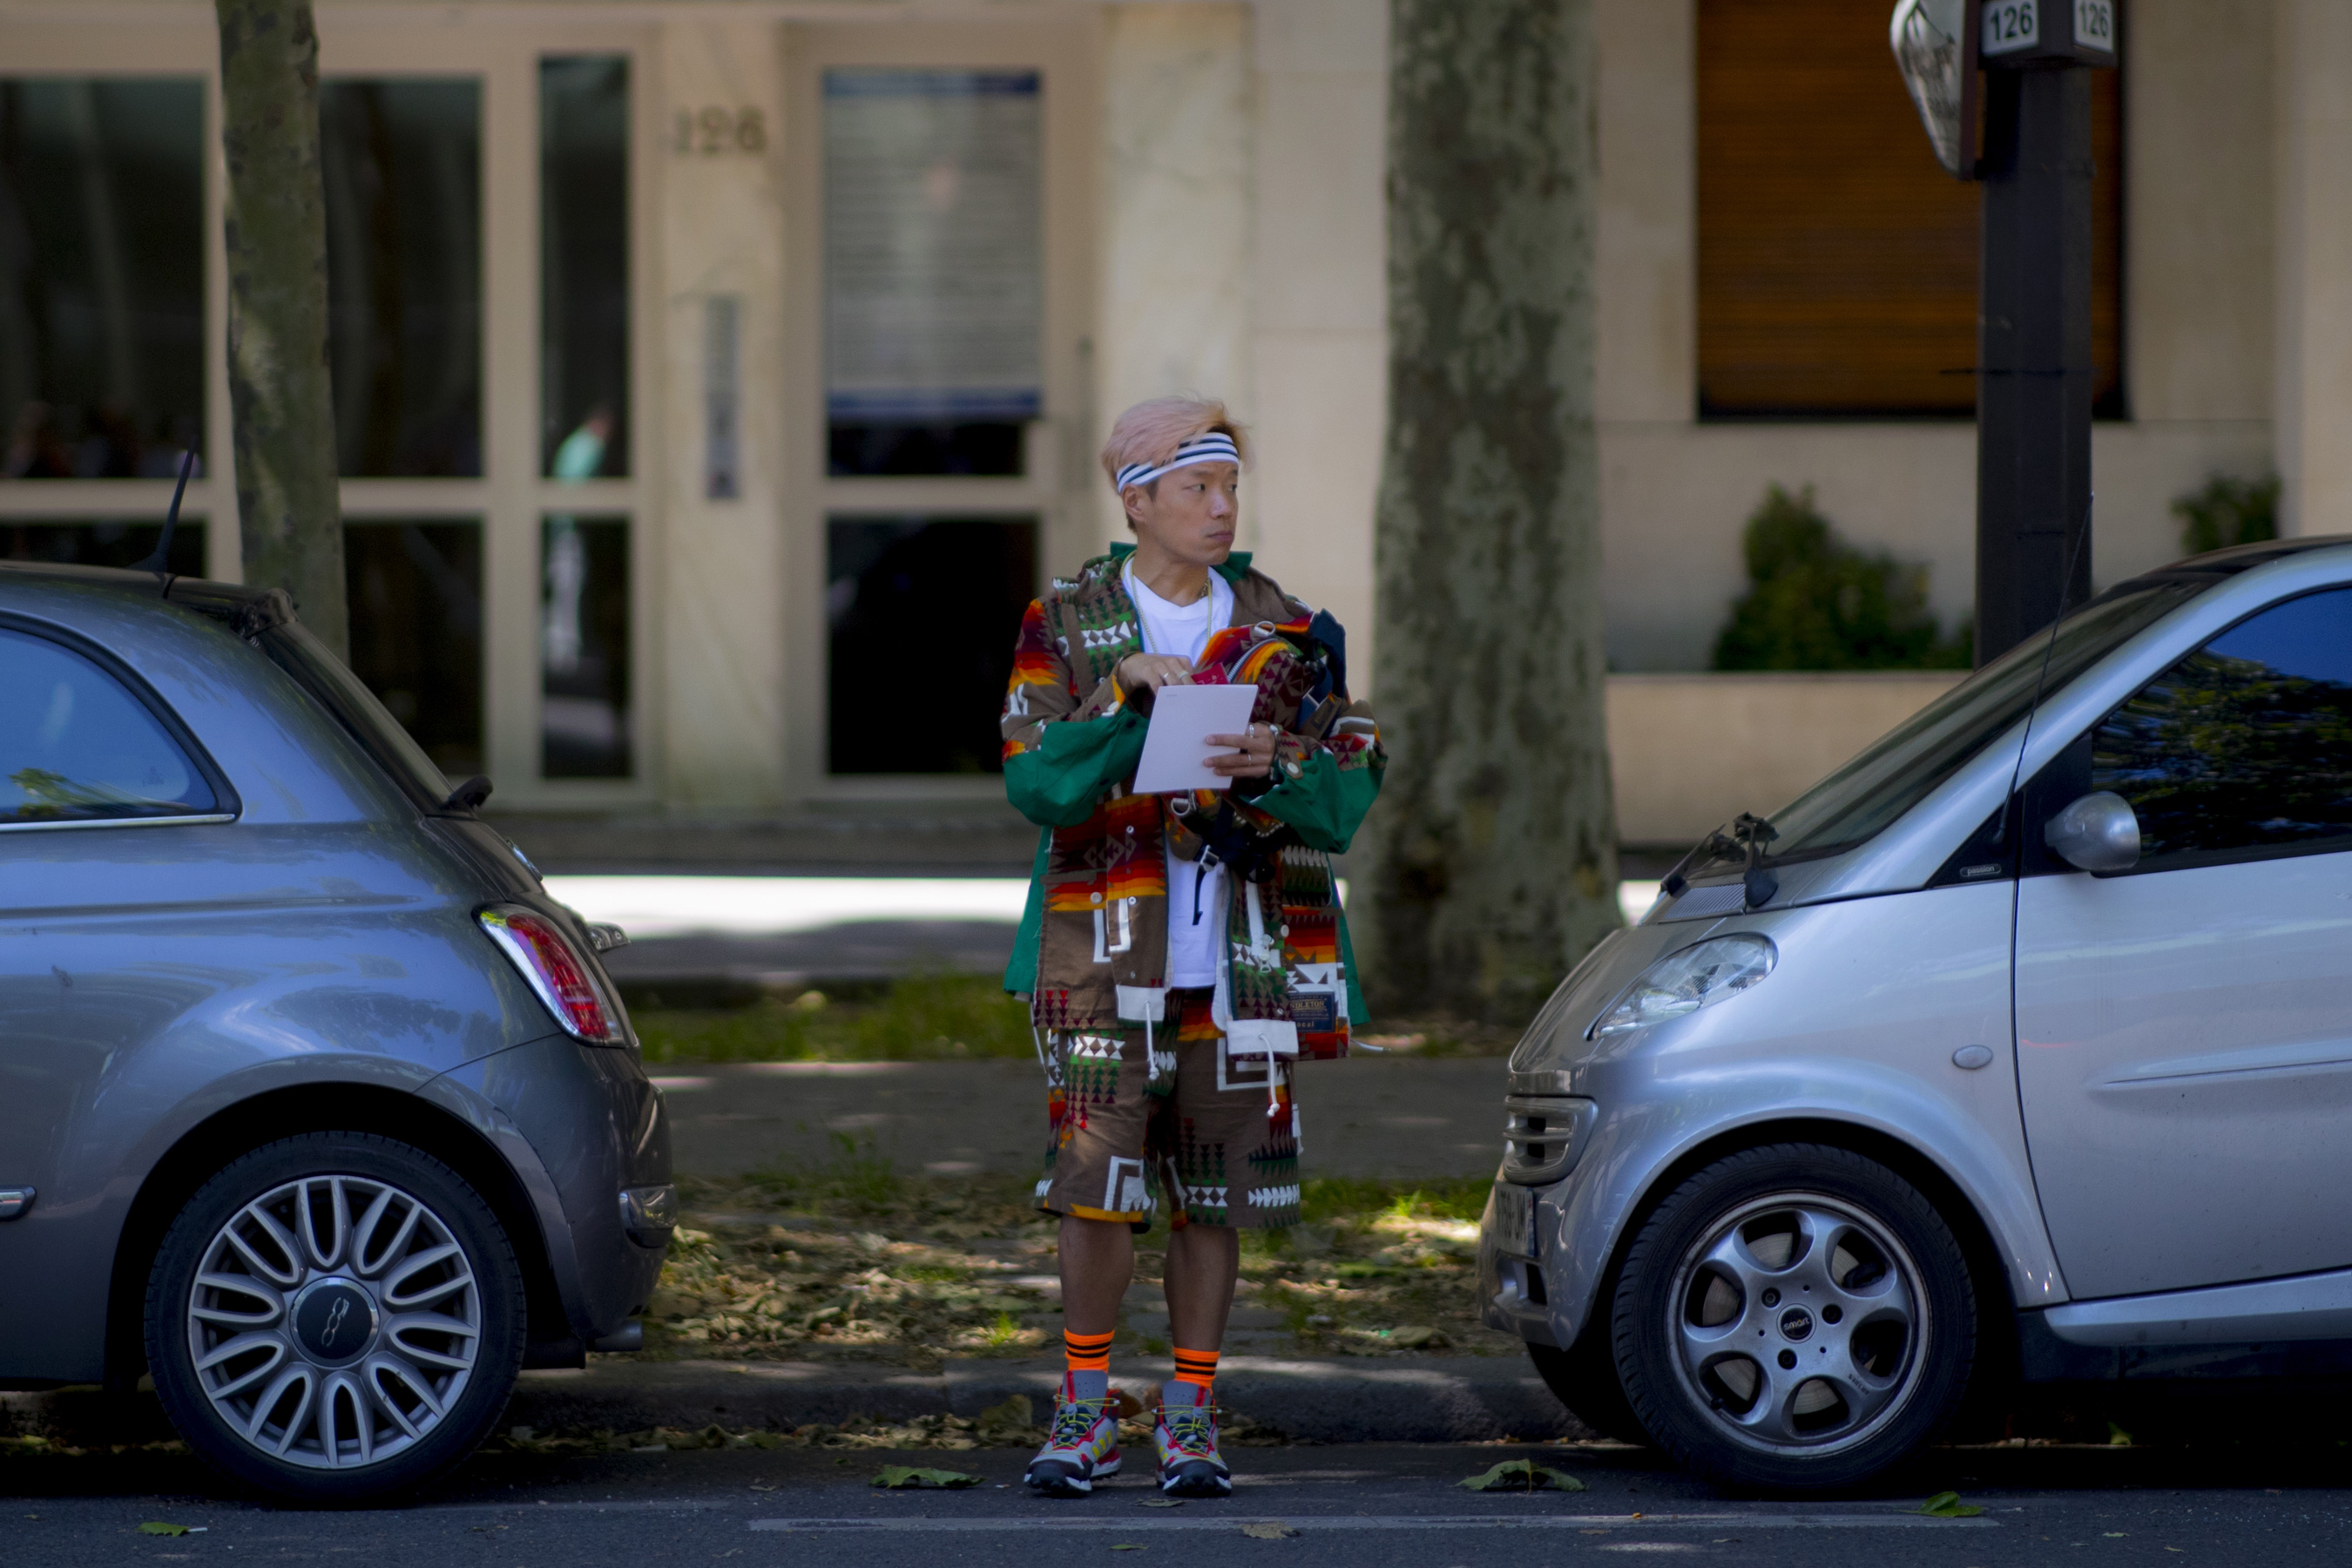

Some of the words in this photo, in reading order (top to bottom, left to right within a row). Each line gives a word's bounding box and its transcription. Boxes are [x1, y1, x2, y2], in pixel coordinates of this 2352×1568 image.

[1990, 2, 2033, 42] 126
[2078, 1, 2109, 38] 126
[1967, 865, 1995, 876] passion
[1289, 999, 1325, 1010] NDLETON
[1783, 1316, 1811, 1331] smart
